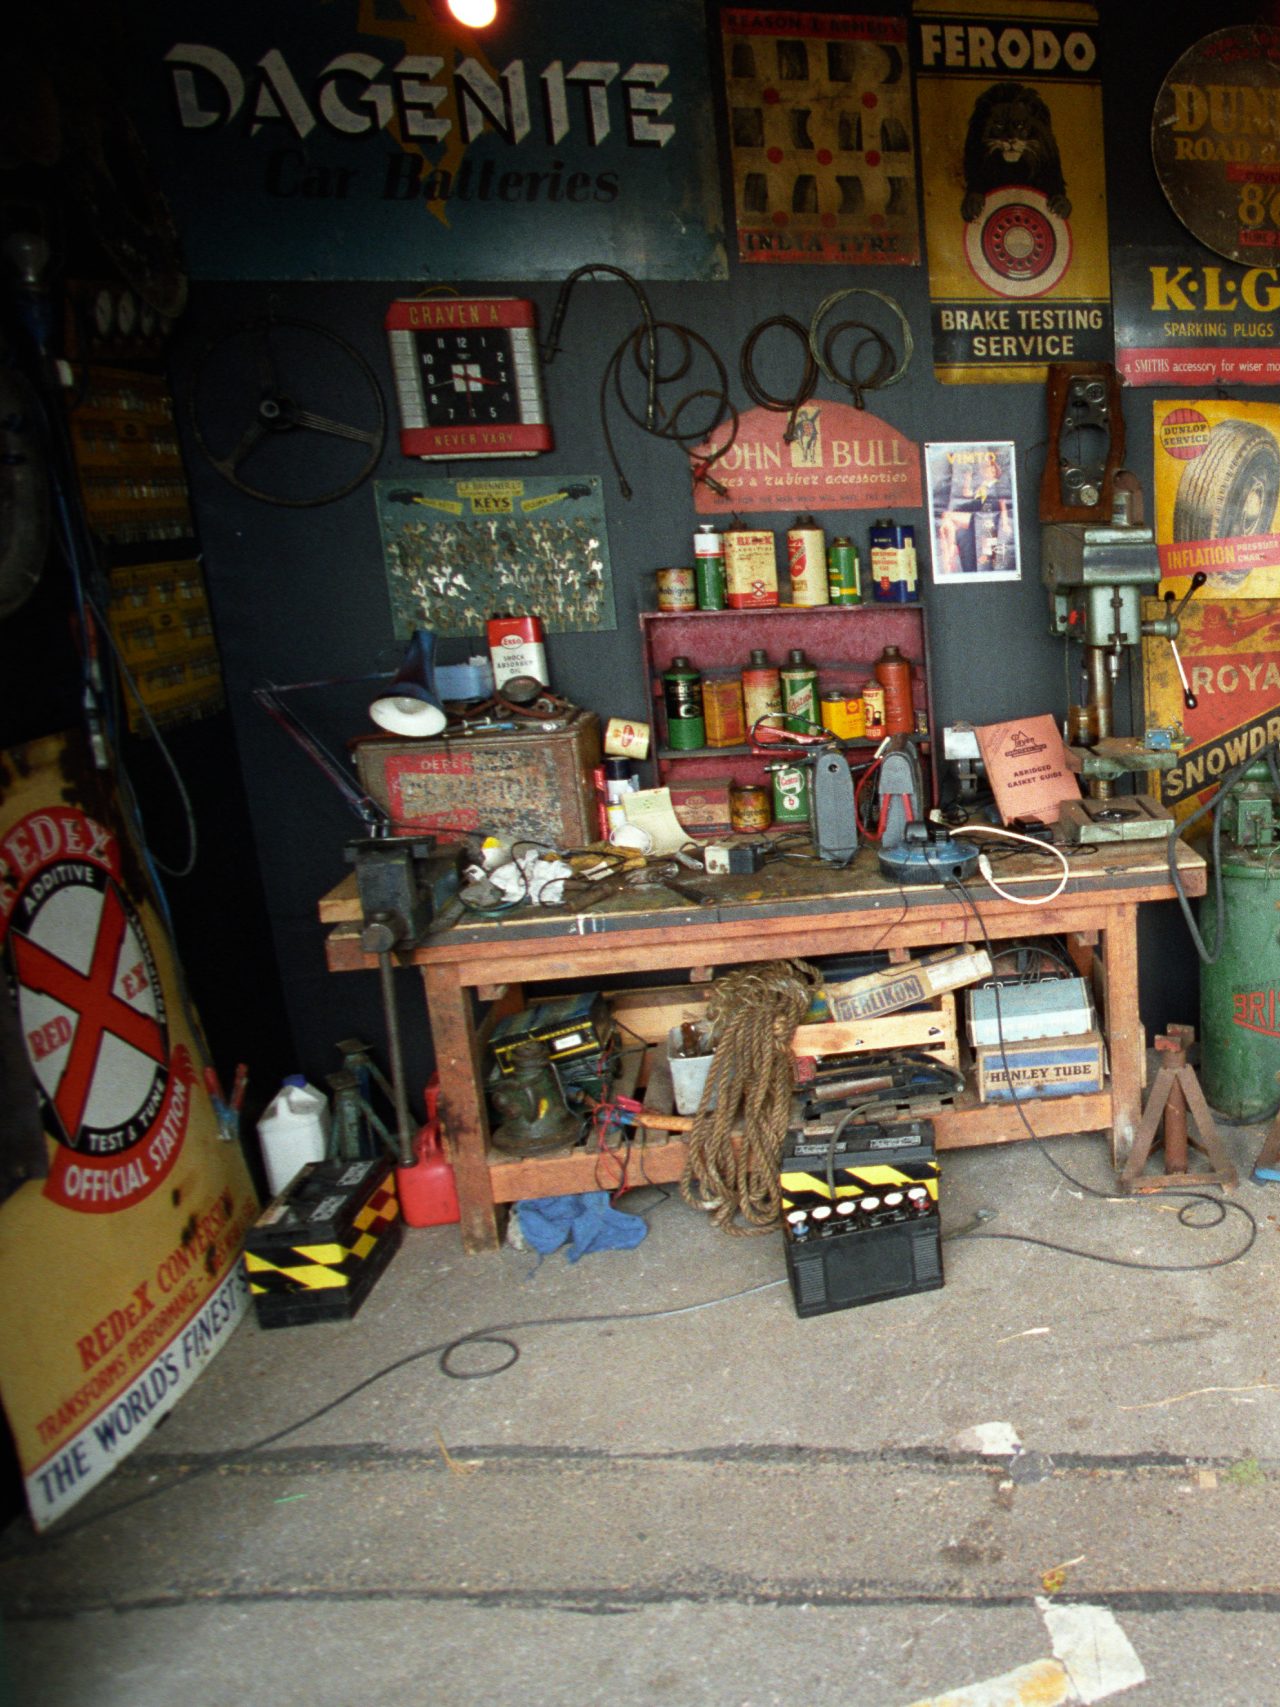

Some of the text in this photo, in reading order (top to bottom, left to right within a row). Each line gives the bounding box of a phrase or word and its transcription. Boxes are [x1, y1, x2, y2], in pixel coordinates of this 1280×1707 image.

[920, 25, 1096, 71] FERODO
[163, 43, 676, 147] DAGENITE
[1174, 137, 1250, 161] ROAD
[263, 150, 620, 202] Car Batteries
[409, 304, 480, 325] CRAVEN
[941, 309, 1103, 332] BRAKE TESTING
[1164, 323, 1274, 337] SPARKING PLUGS
[457, 337, 467, 348] 12
[972, 335, 1074, 356] SERVICE
[423, 354, 433, 364] 10
[497, 352, 505, 362] 2
[1124, 363, 1131, 373] a
[1135, 359, 1169, 373] SMITHS
[1172, 361, 1216, 374] accessory
[1221, 360, 1234, 372] for
[1239, 361, 1263, 372] wiser
[428, 374, 435, 384] 9
[434, 432, 513, 446] NEVER VARY
[1163, 423, 1207, 436] DUNLOP
[1163, 434, 1208, 446] SERVICE
[832, 439, 908, 467] BULL
[946, 452, 996, 464] VIMTO
[825, 471, 907, 485] accessories
[474, 497, 511, 508] KEYS
[1167, 544, 1235, 570] INFLATION
[1007, 771, 1062, 788] GASKET GUIDE
[1013, 764, 1052, 778] ABRIDGED
[0, 815, 113, 917] EDEX
[24, 864, 95, 915] ADDITIVE
[27, 961, 149, 1062] RED EX
[990, 1067, 1049, 1082] HENLEY
[1053, 1064, 1092, 1076] TUBE
[89, 1132, 126, 1153] TEST
[142, 1081, 166, 1129] TUNE
[64, 1079, 188, 1201] OFFICIAL STATION
[76, 1280, 156, 1372] REDEX
[36, 1441, 91, 1503] THE
[94, 1353, 181, 1452] WORLD'S
[181, 1279, 238, 1368] FINEST
[36, 1353, 128, 1445] TRANSFORMS
